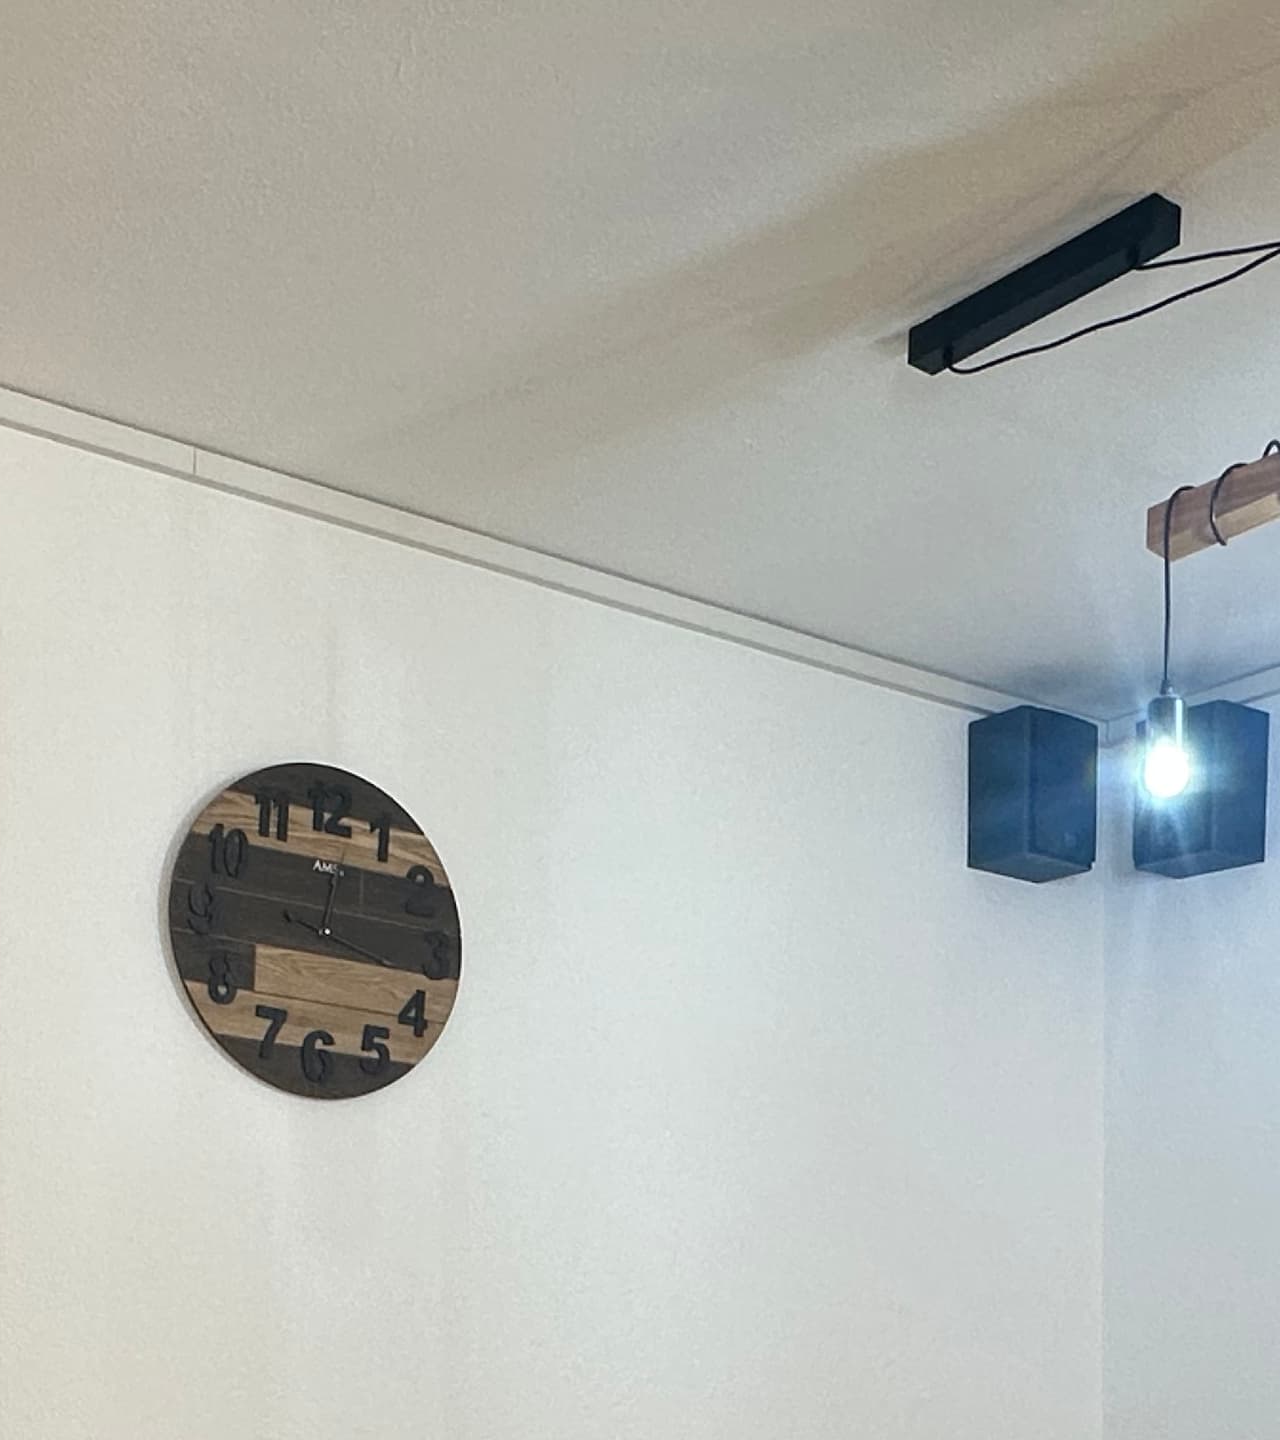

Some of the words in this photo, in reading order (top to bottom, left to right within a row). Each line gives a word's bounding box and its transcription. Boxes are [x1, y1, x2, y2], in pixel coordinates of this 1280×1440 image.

[255, 787, 290, 842] 11
[307, 782, 353, 839] 12
[370, 811, 391, 863] 1
[208, 823, 249, 879] 10
[403, 865, 435, 918] 2
[208, 952, 238, 1005] 8
[421, 931, 451, 981] 3
[255, 1004, 289, 1059] 7
[397, 988, 429, 1038] 4
[300, 1029, 336, 1084] 6
[359, 1023, 391, 1076] 5
